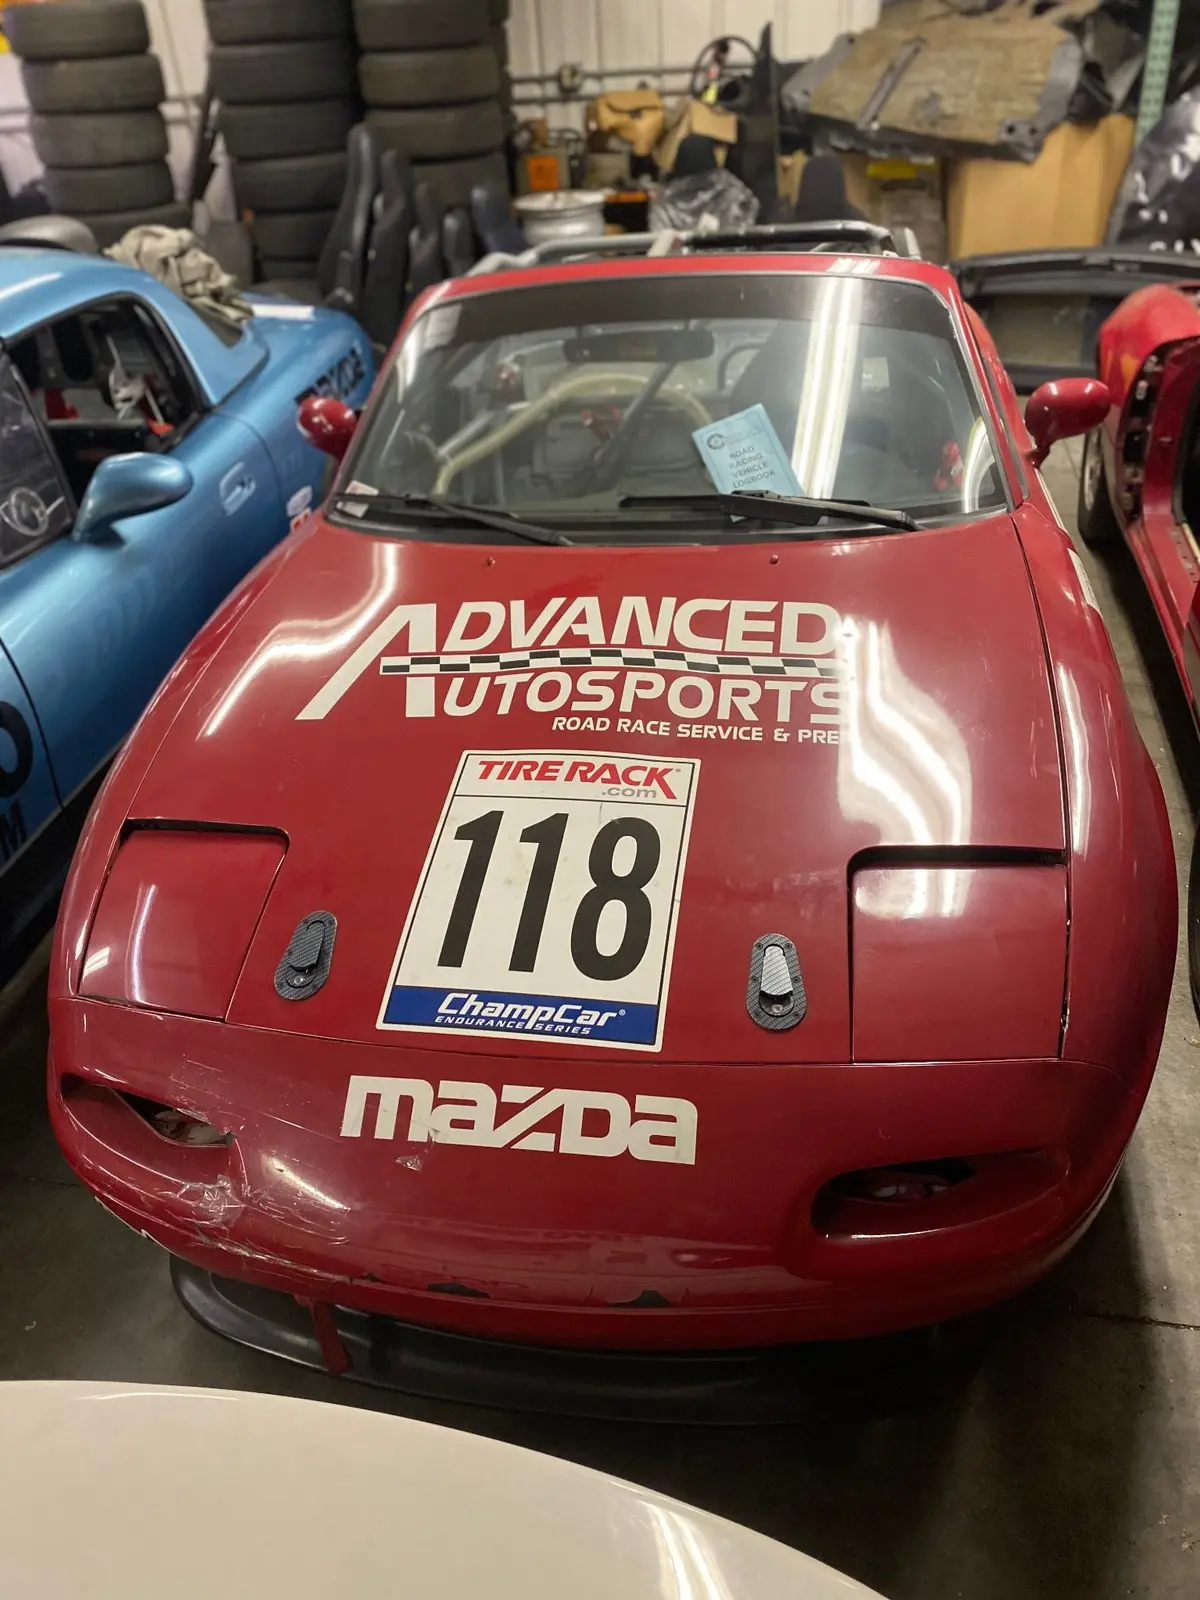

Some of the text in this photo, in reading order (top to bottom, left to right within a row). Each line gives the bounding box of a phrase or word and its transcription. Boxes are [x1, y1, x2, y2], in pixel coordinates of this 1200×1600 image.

[729, 445, 755, 460] ROAD
[732, 462, 769, 479] VEHICLE
[732, 469, 776, 489] LOGBOOK
[295, 596, 843, 675] ADVANCED
[552, 716, 841, 745] ROAD RACE SERVICE & PRE
[478, 760, 678, 800] TIRE RACK
[601, 785, 657, 799] .com
[437, 810, 661, 981] 118
[437, 992, 617, 1029] ChampCar
[434, 1015, 592, 1035] ENDURANCE SERIES
